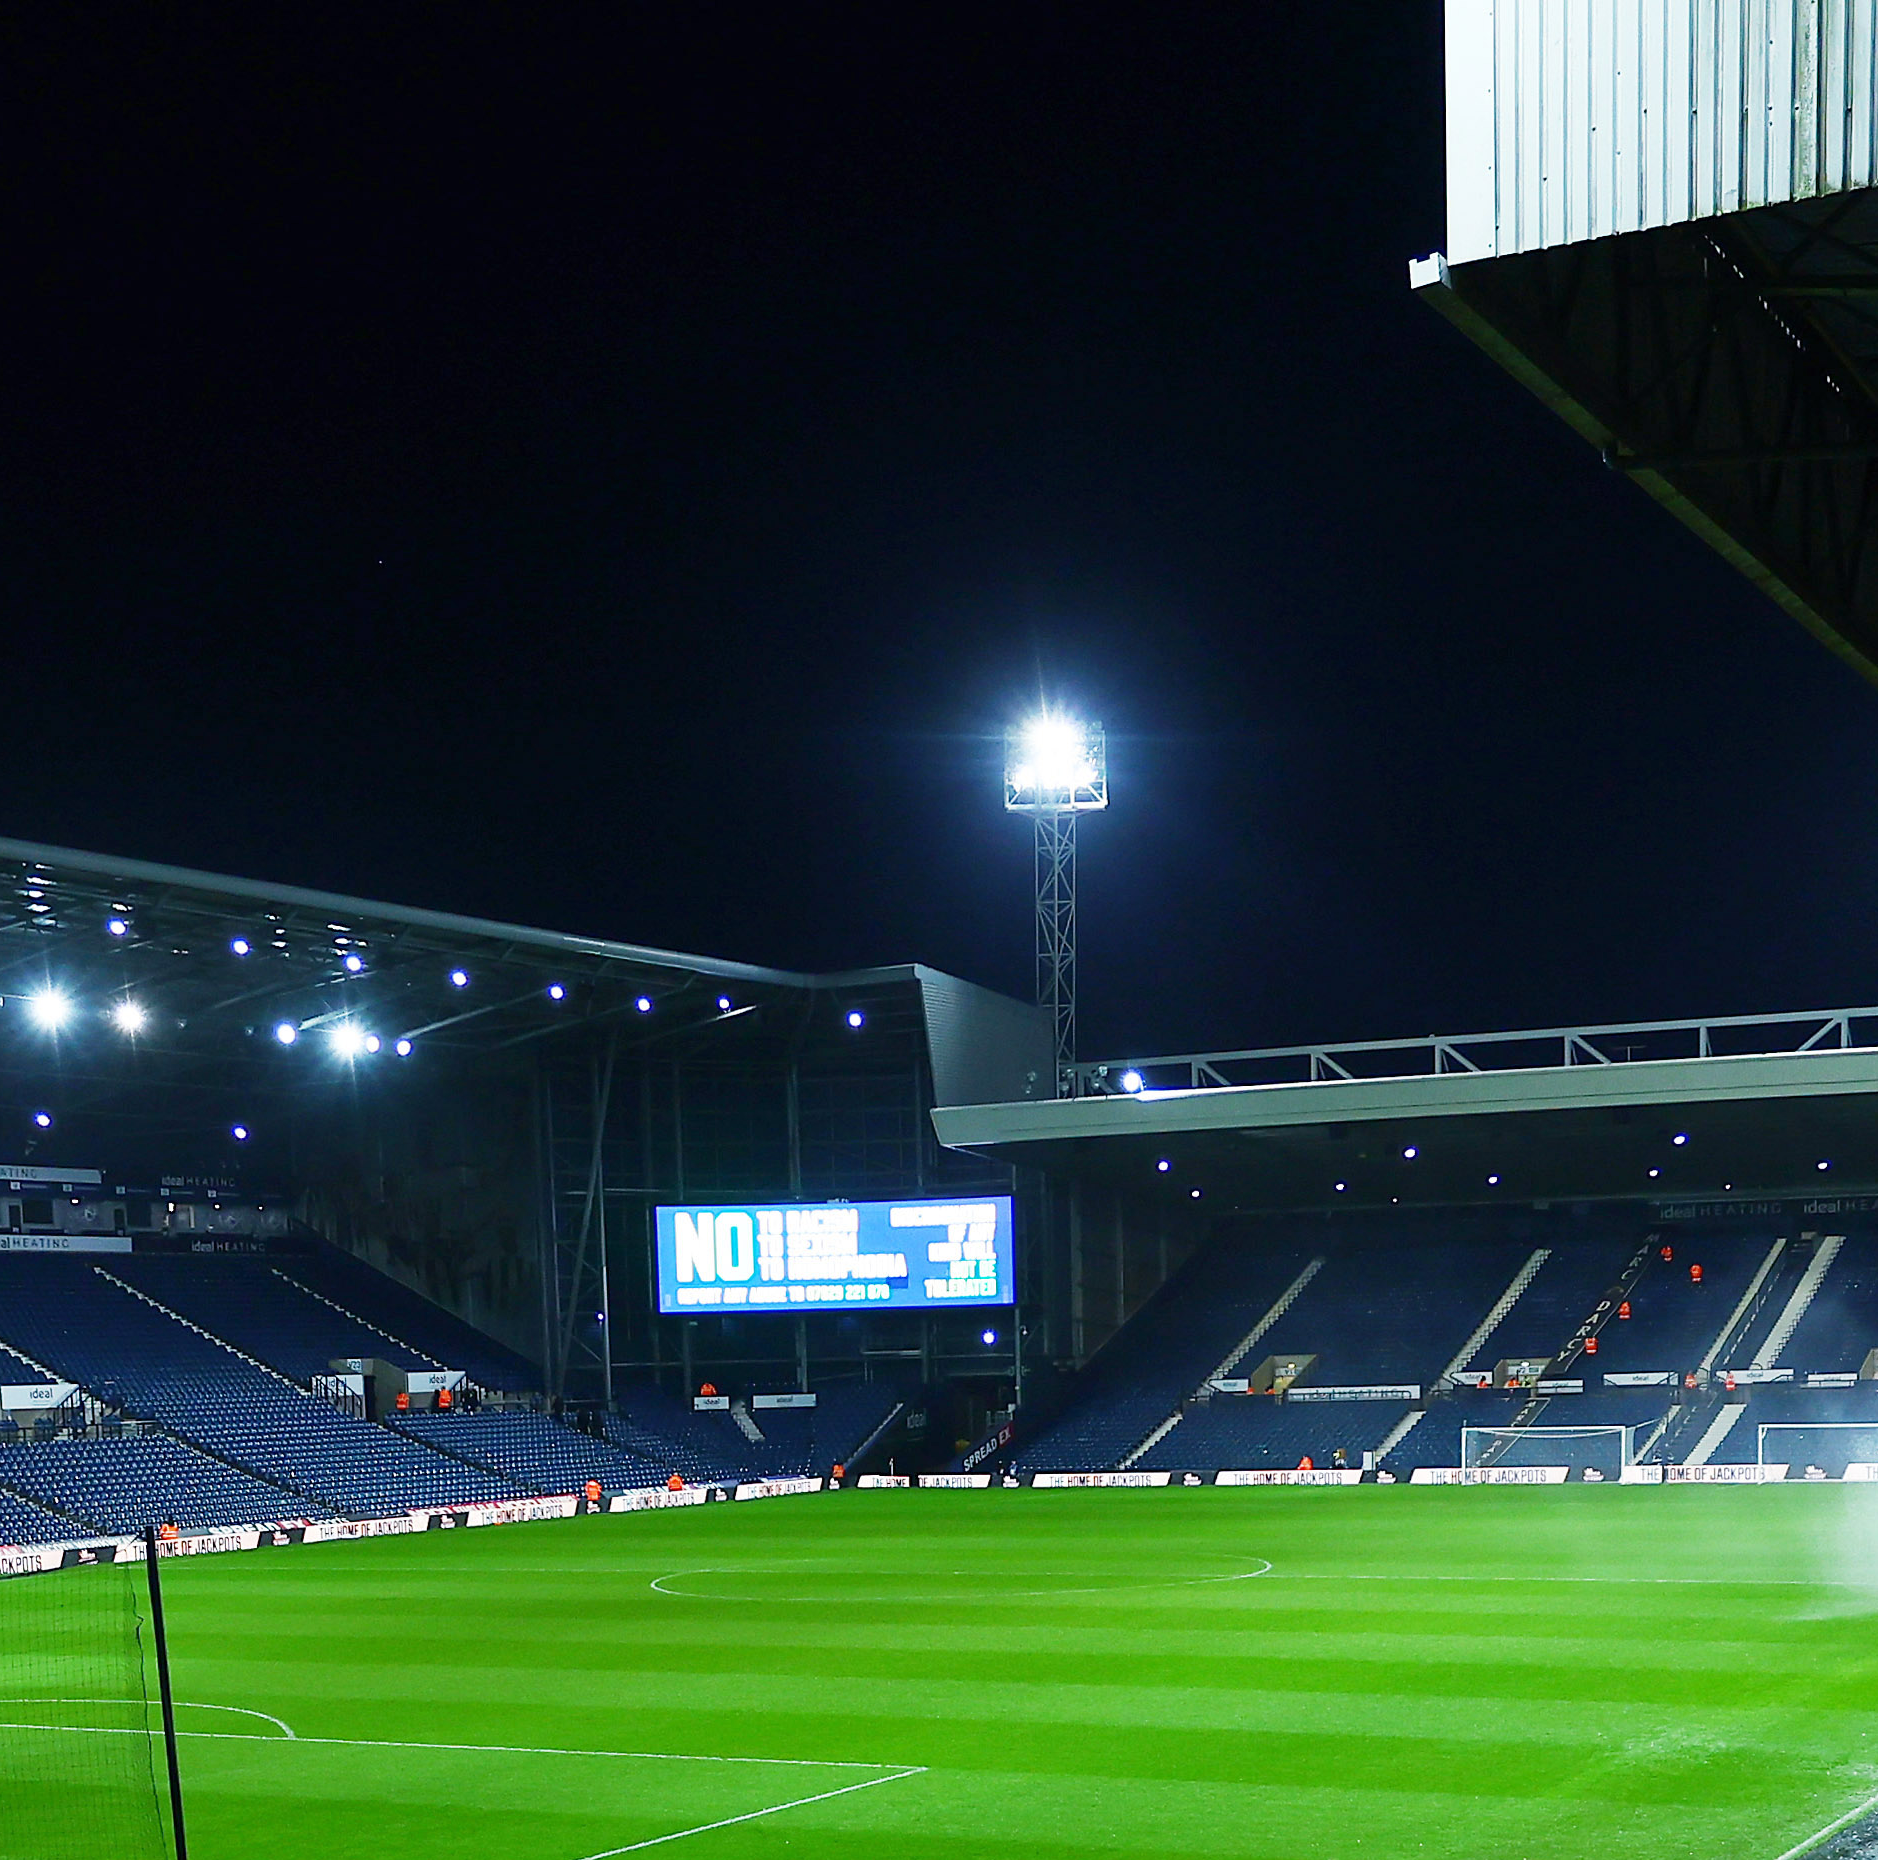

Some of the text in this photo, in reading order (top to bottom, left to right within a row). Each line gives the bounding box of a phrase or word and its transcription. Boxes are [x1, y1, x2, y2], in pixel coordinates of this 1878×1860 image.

[12, 1240, 70, 1250] HEATING
[674, 1211, 755, 1282] NO
[29, 1387, 54, 1399] ideal
[1067, 1475, 1090, 1487] HOME
[1093, 1475, 1103, 1487] OF
[1105, 1474, 1152, 1487] JACKPOTS
[1234, 1471, 1342, 1486] THE HOME OF JACKPOTS
[1431, 1470, 1447, 1484] THE
[1479, 1469, 1491, 1482] OF
[1494, 1468, 1547, 1483] JACKPOTS
[1641, 1468, 1658, 1483] THE
[1693, 1467, 1706, 1481] OF
[336, 1523, 359, 1537] HOME
[361, 1522, 370, 1535] OF
[373, 1517, 414, 1535] JACKPOTS
[181, 1540, 193, 1556] OF
[195, 1535, 241, 1554] JACKPOTS
